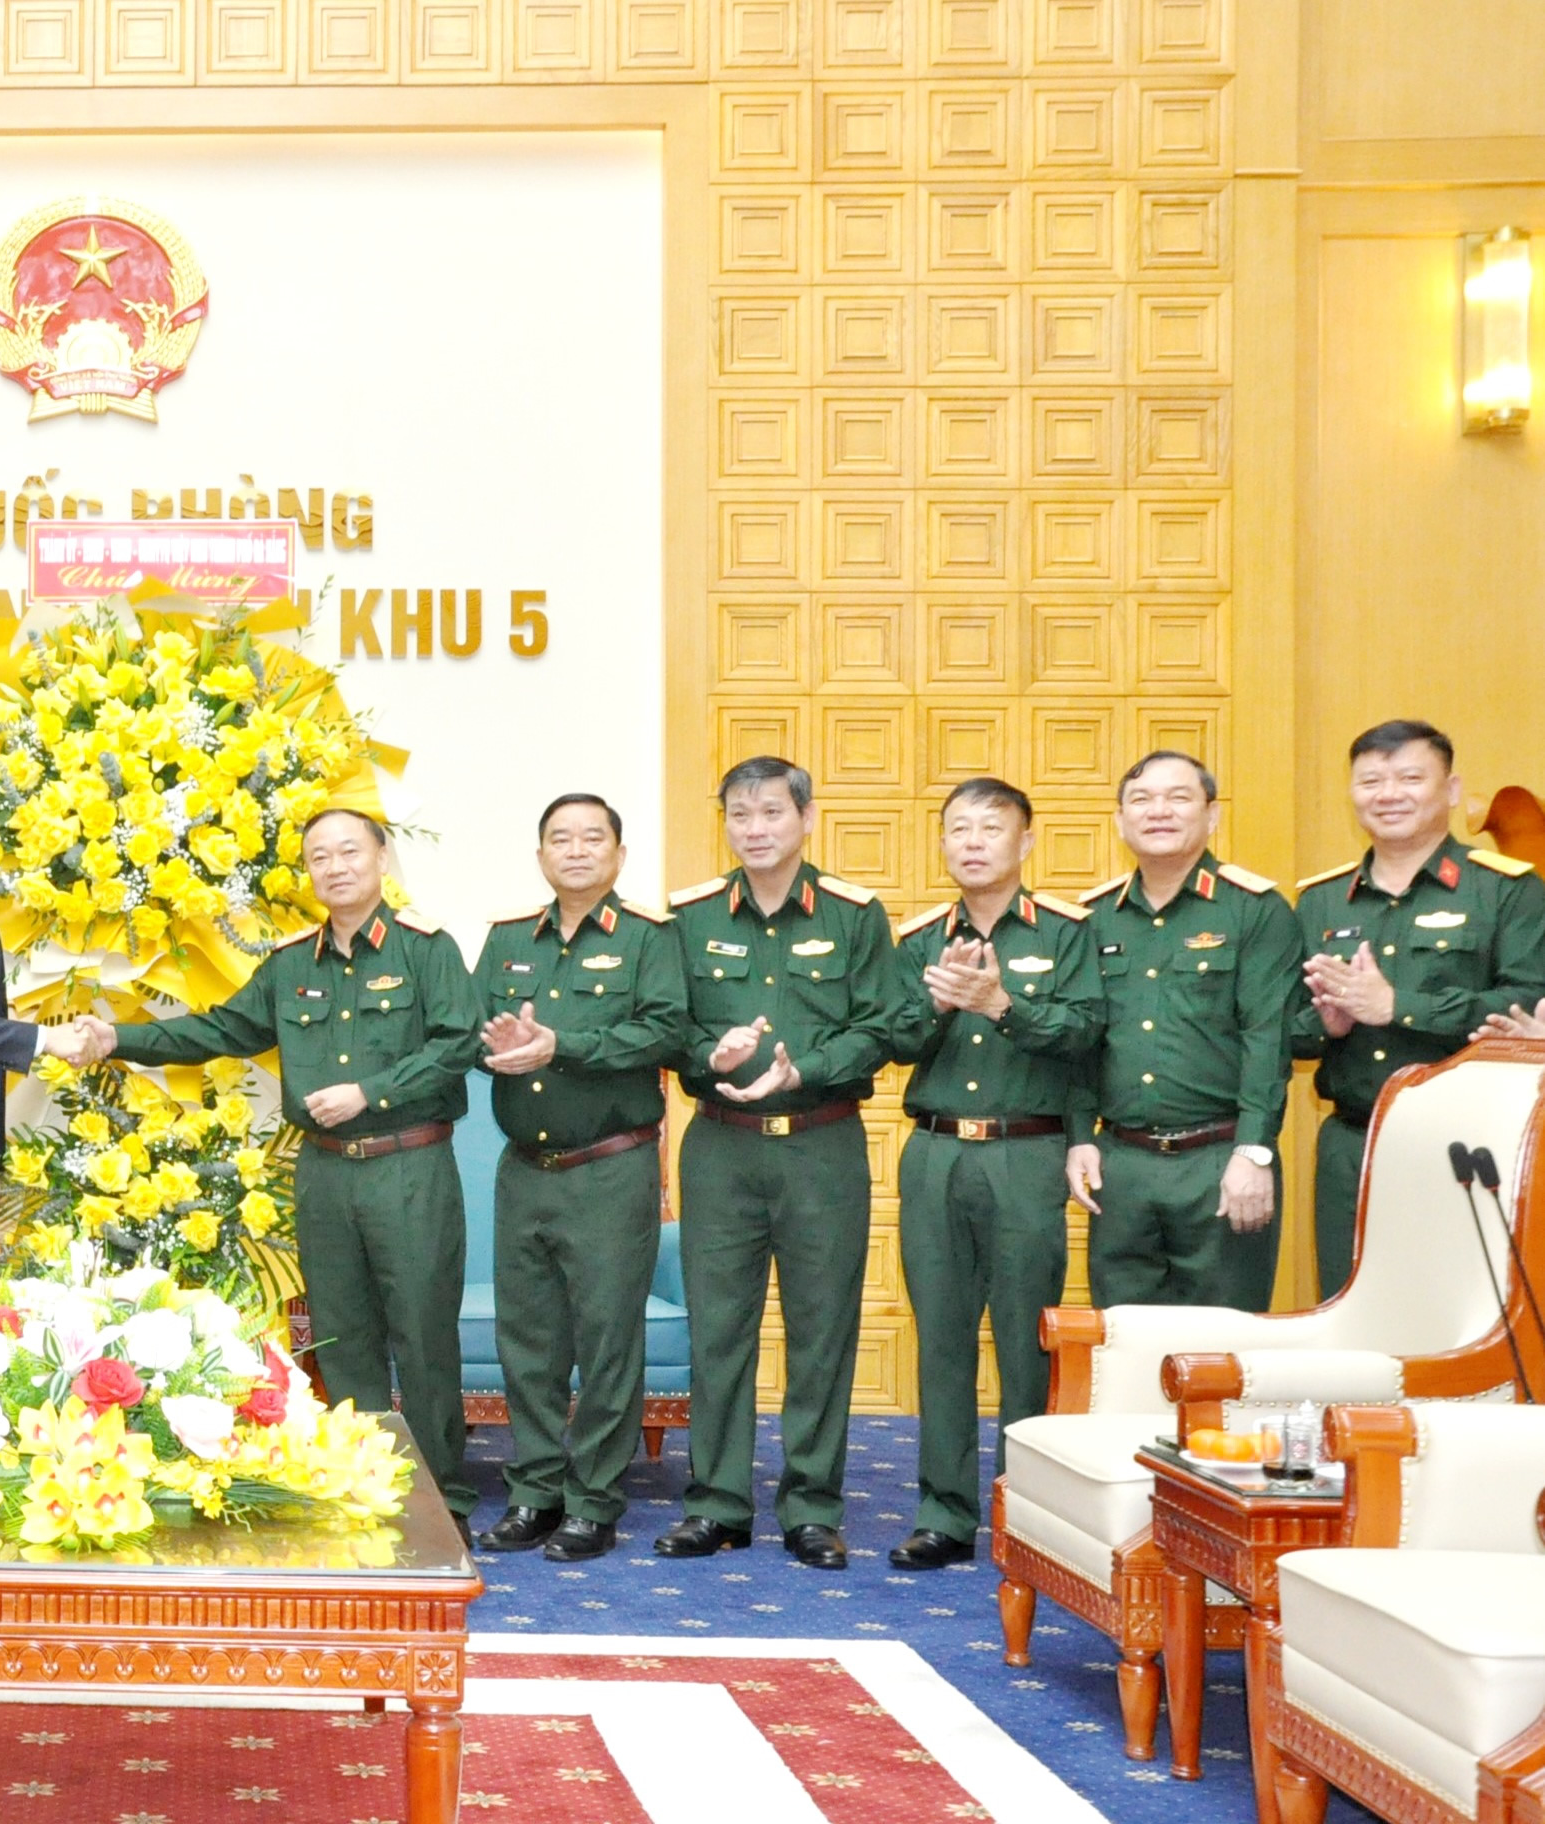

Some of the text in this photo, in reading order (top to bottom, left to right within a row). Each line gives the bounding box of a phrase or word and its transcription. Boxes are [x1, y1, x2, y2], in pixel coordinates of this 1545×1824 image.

[57, 565, 128, 588] Chú
[340, 588, 483, 659] KHU
[508, 589, 549, 657] 5
